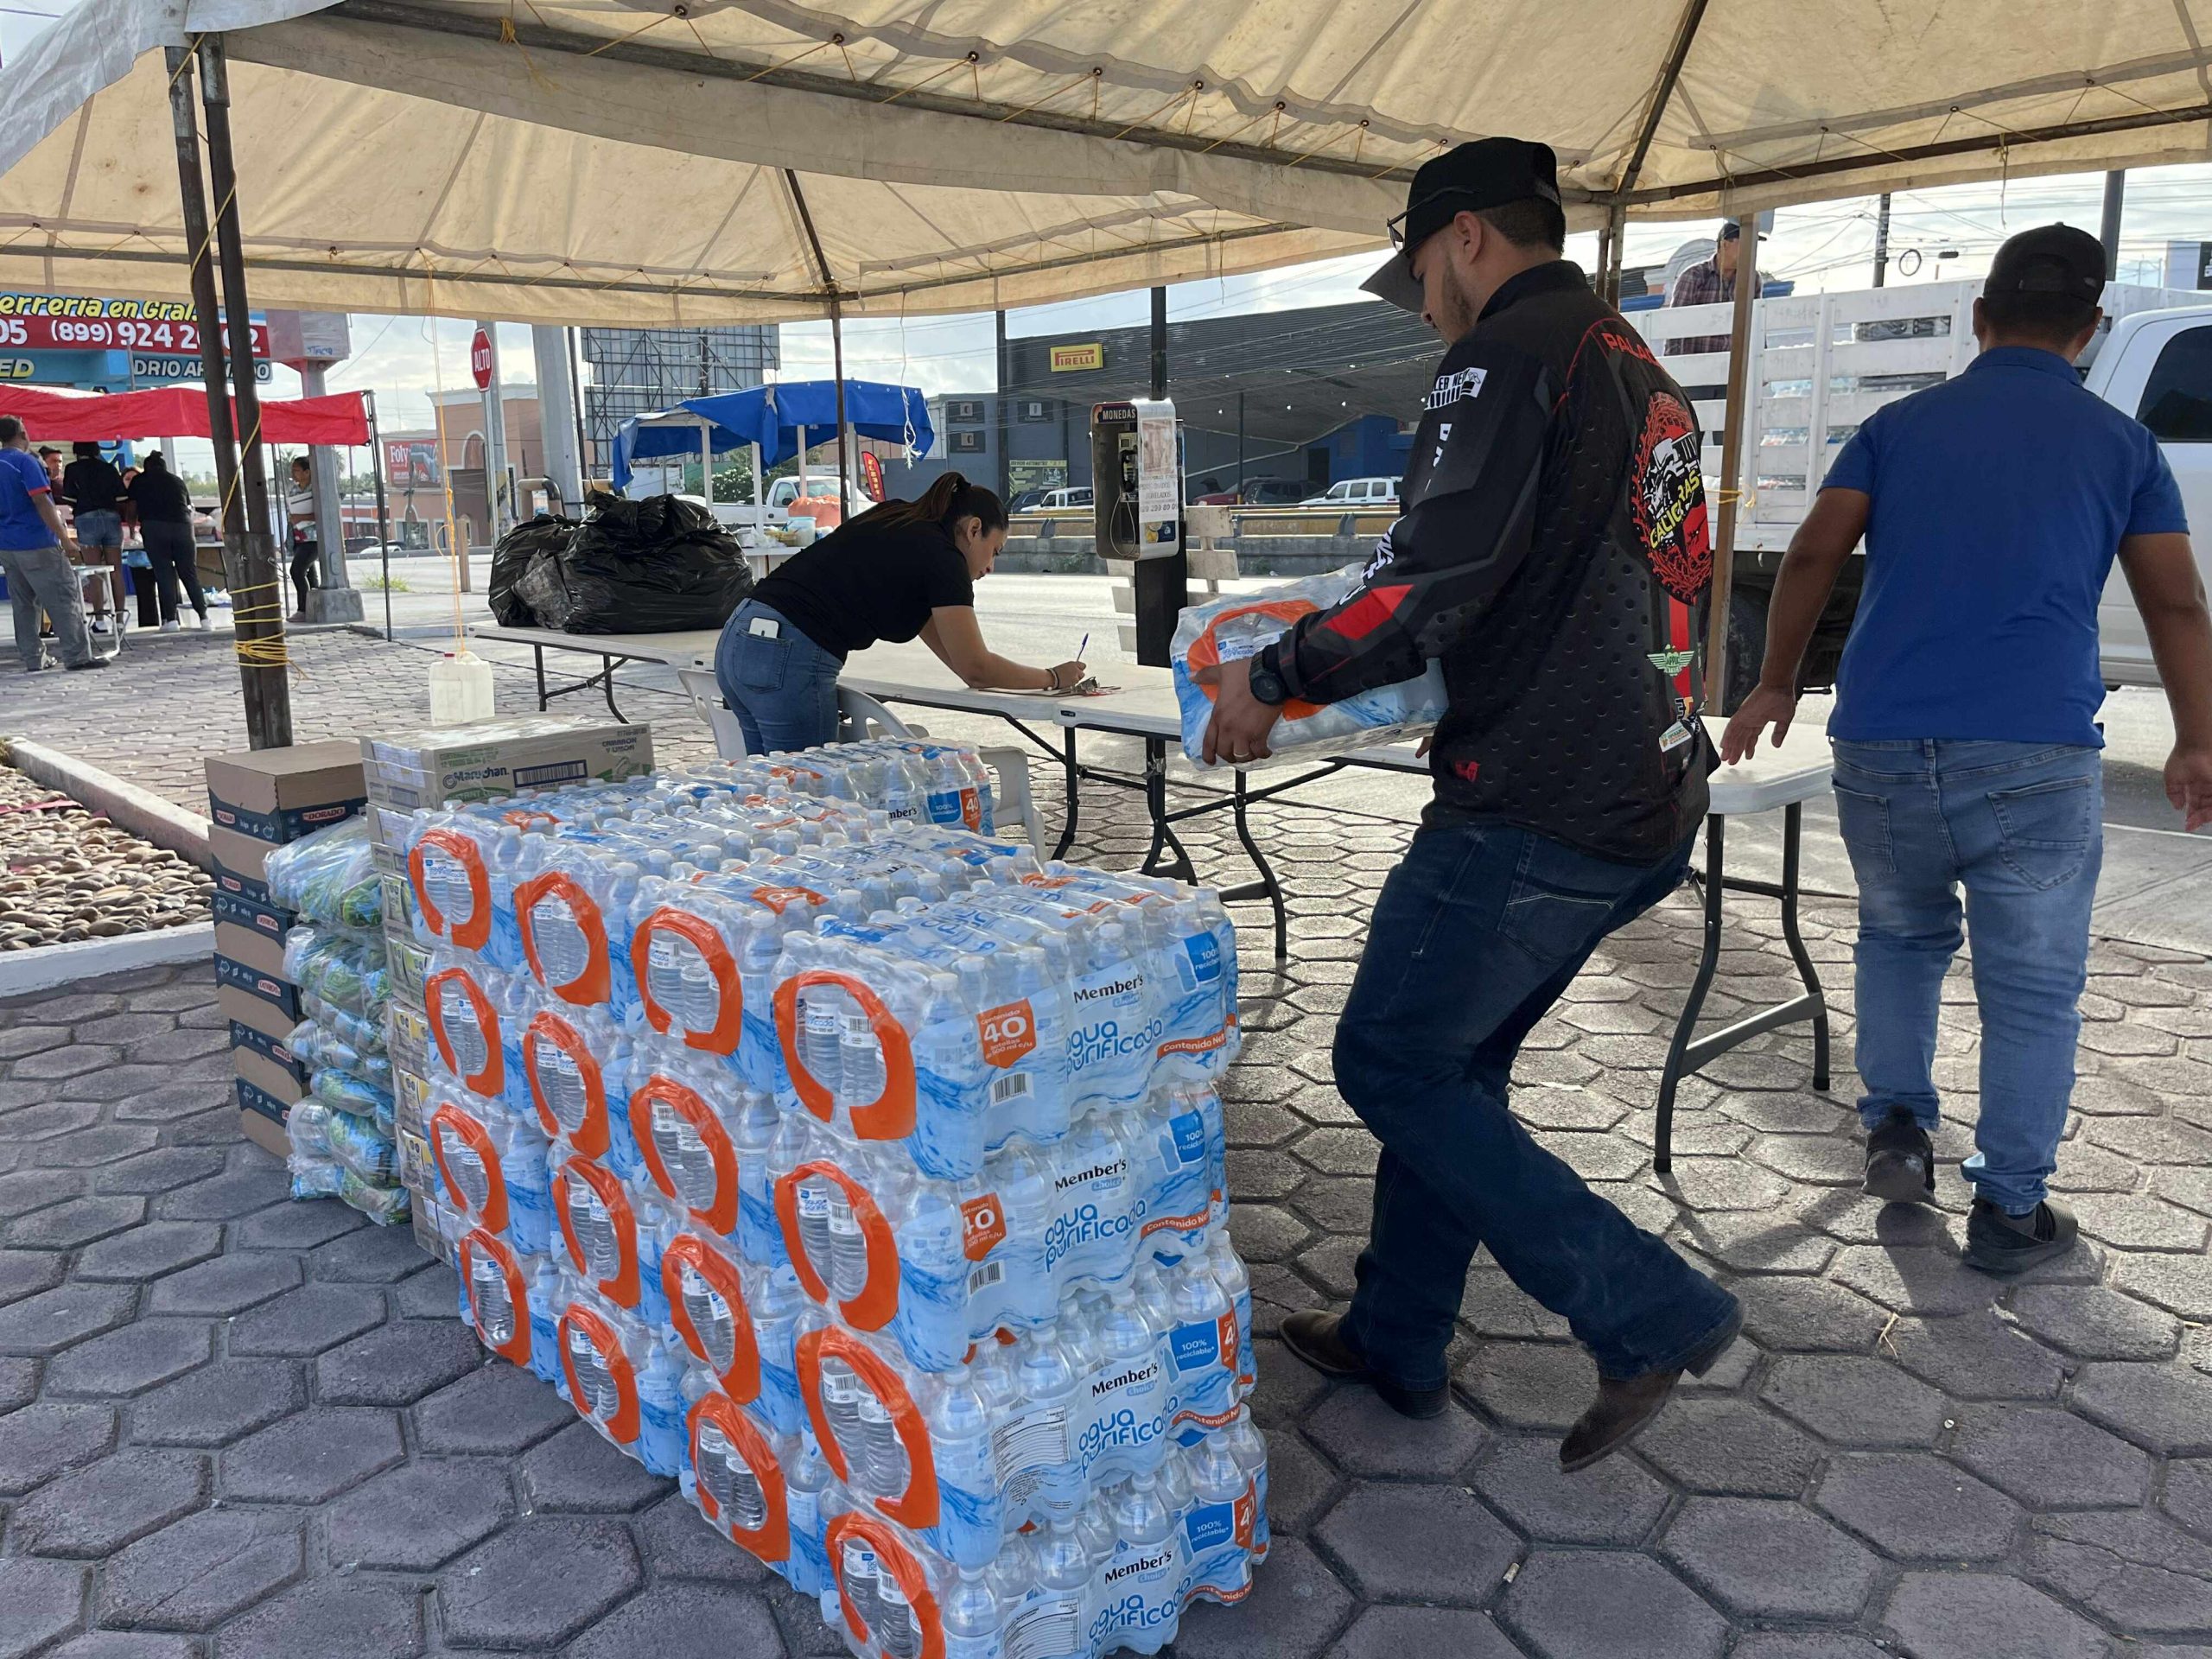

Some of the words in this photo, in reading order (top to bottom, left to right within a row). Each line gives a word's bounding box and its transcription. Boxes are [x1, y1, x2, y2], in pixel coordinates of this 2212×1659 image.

[109, 300, 139, 319] en
[51, 320, 112, 345] (899)
[118, 321, 174, 348] 924
[474, 347, 491, 372] ALTO
[1054, 349, 1095, 366] PIRELLI
[1103, 409, 1136, 420] MONEDAS
[966, 797, 979, 812] 40
[1073, 974, 1143, 1004] Member's
[983, 1016, 1027, 1043] 40
[1065, 1020, 1118, 1058] agua
[1065, 1017, 1163, 1084] purificada
[1163, 1039, 1213, 1053] Contenido
[1054, 1158, 1127, 1192] Member's
[1045, 1204, 1098, 1246] agua
[1045, 1199, 1147, 1274] purificada
[1147, 1217, 1198, 1232] Contenido
[1181, 1339, 1207, 1351] 100%
[1091, 1362, 1158, 1397] Member's
[1078, 1409, 1135, 1452] agua
[1179, 1410, 1230, 1426] Contenido
[1080, 1395, 1179, 1478] purificada
[1197, 1520, 1222, 1533] 100%
[1103, 1549, 1173, 1585] Member's
[1089, 1594, 1145, 1640] agua
[1090, 1576, 1192, 1659] purificada
